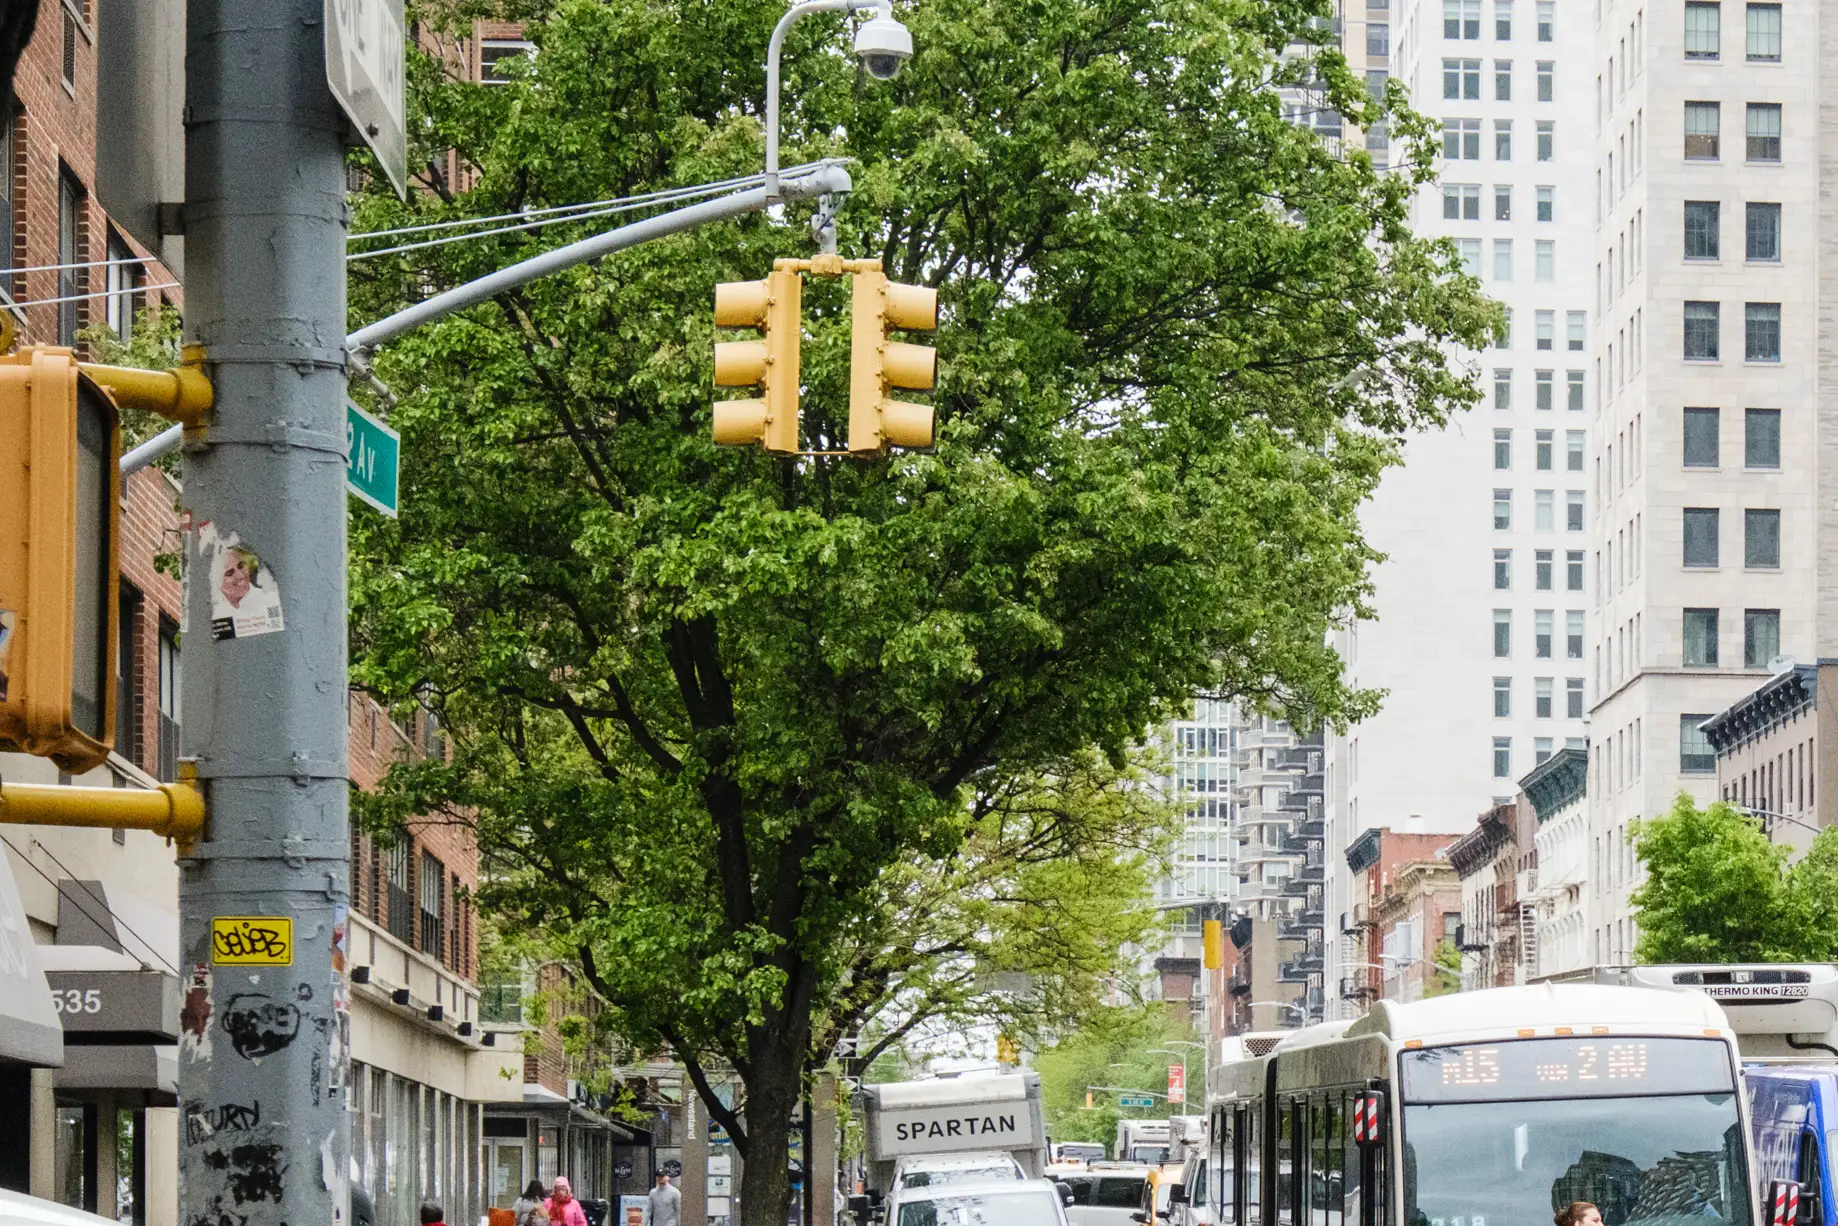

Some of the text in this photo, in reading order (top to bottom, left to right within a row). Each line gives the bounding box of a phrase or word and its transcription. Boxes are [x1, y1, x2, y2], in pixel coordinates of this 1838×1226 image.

[1704, 987, 1750, 996] THERMO
[1753, 986, 1778, 995] KING
[896, 1115, 1015, 1141] SPARTAN
